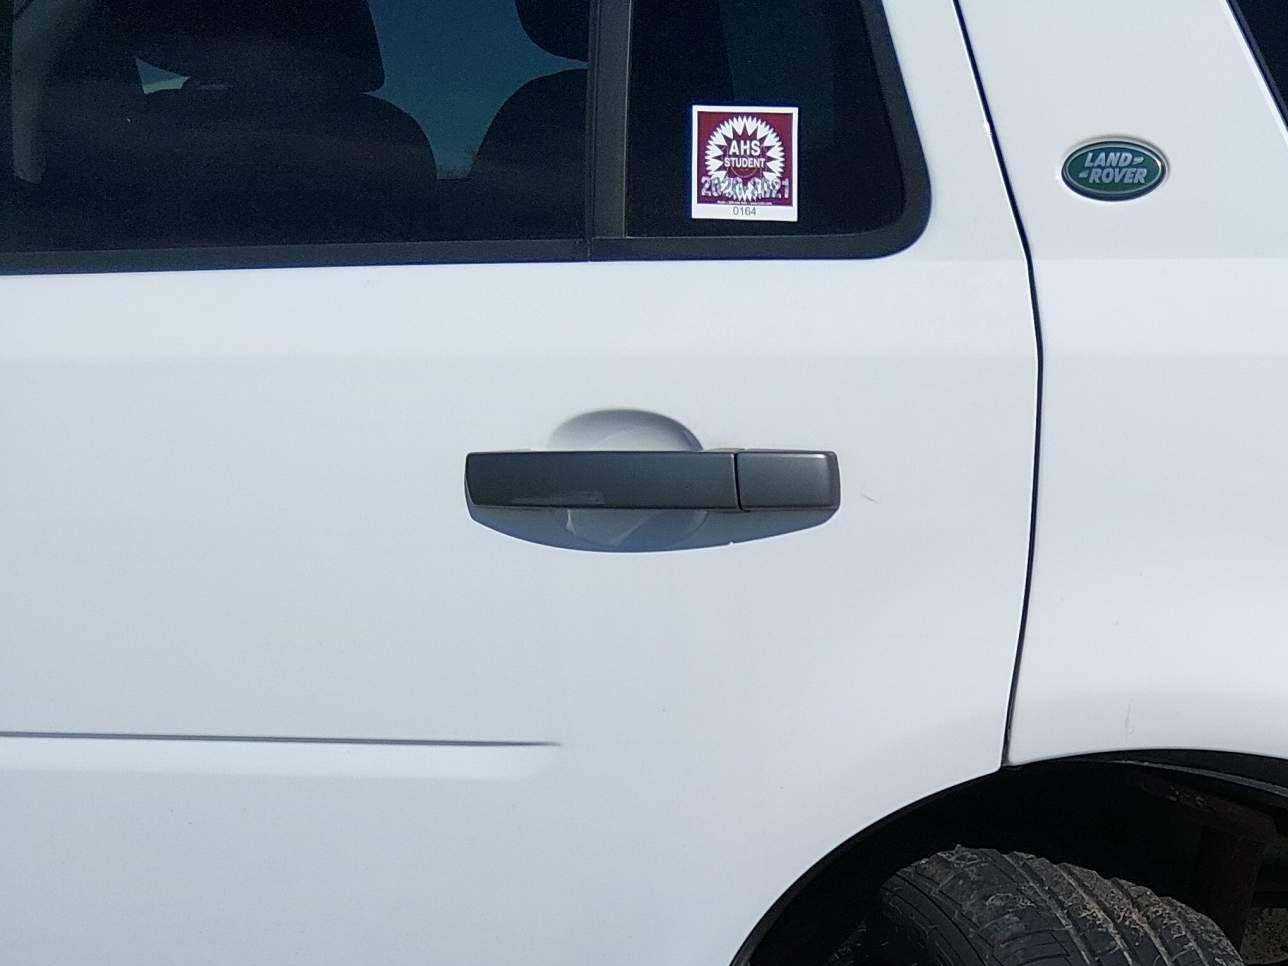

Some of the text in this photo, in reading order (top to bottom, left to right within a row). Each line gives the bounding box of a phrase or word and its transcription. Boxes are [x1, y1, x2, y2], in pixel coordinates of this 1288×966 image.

[729, 139, 761, 156] AHS
[723, 157, 766, 168] STUDENT
[1084, 152, 1133, 167] LAND
[1089, 168, 1147, 183] ROVER
[732, 206, 757, 216] 0164
